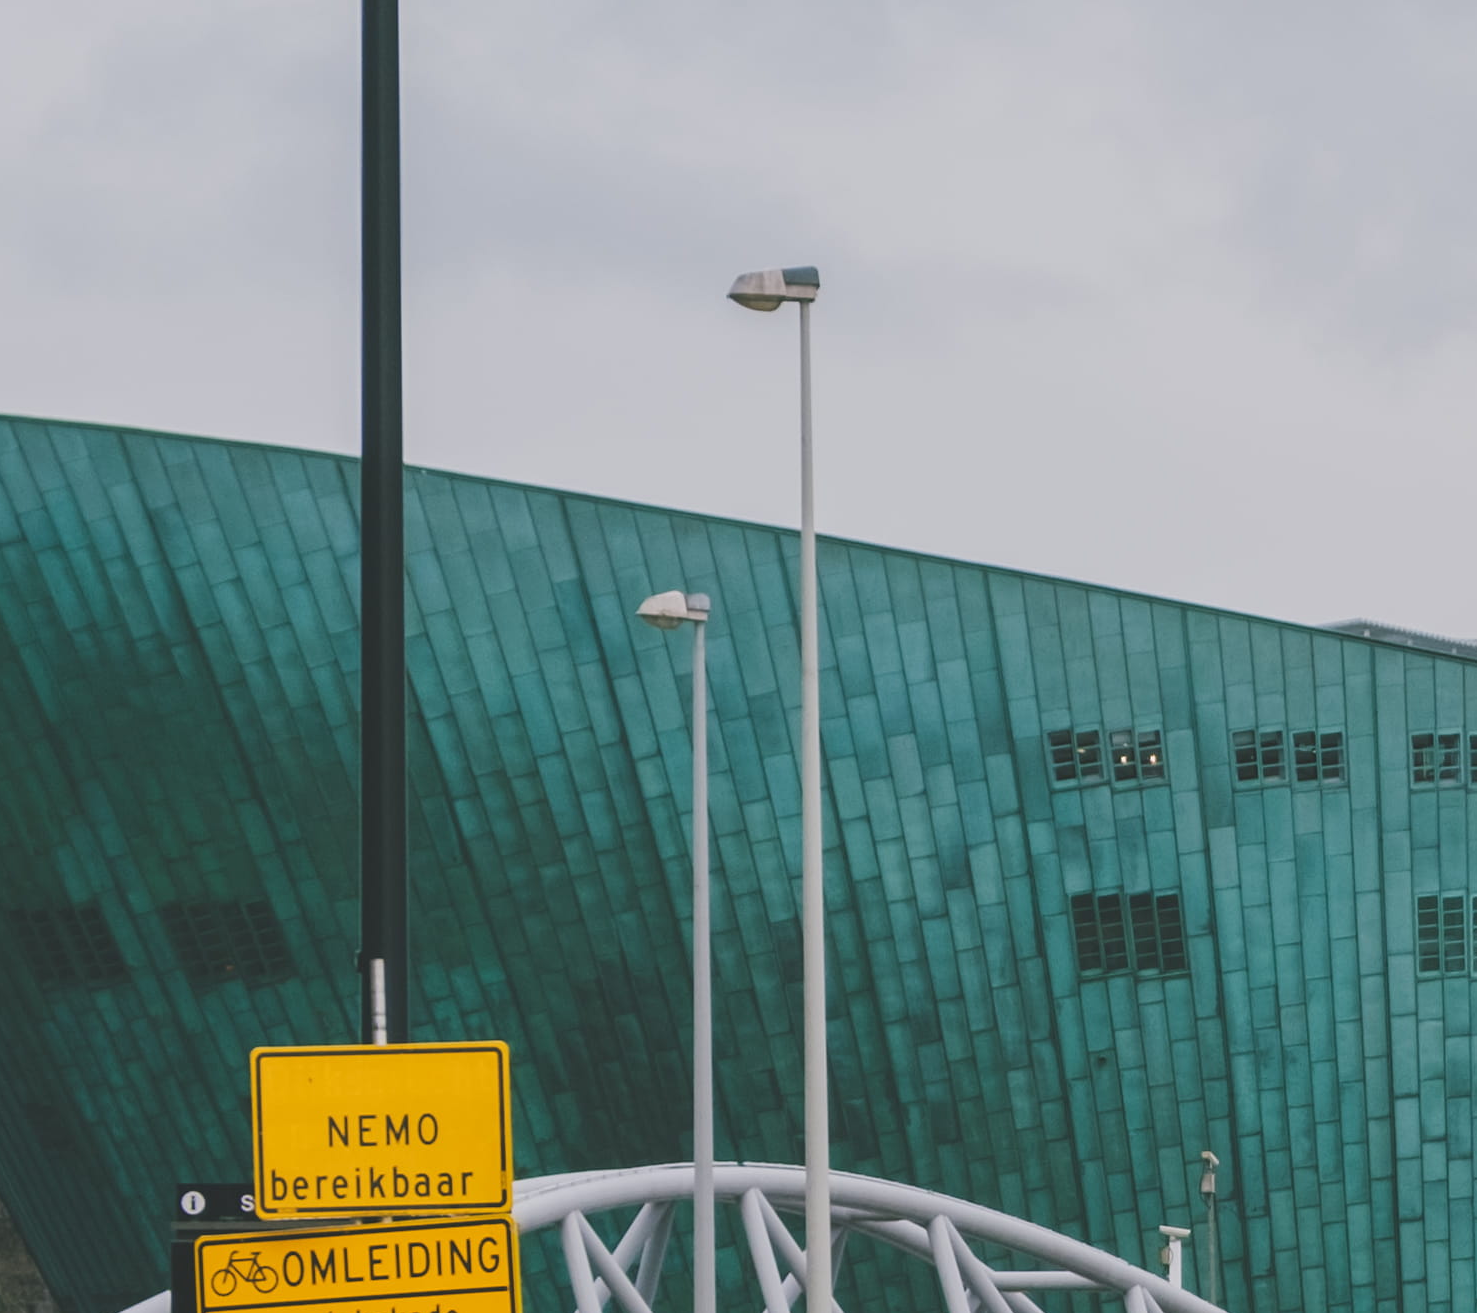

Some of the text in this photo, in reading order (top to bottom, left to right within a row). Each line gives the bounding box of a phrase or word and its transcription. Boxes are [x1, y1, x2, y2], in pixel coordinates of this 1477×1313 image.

[327, 1112, 439, 1148] NEMO
[271, 1167, 473, 1201] bereikbaar
[282, 1236, 500, 1287] OMLEIDING
